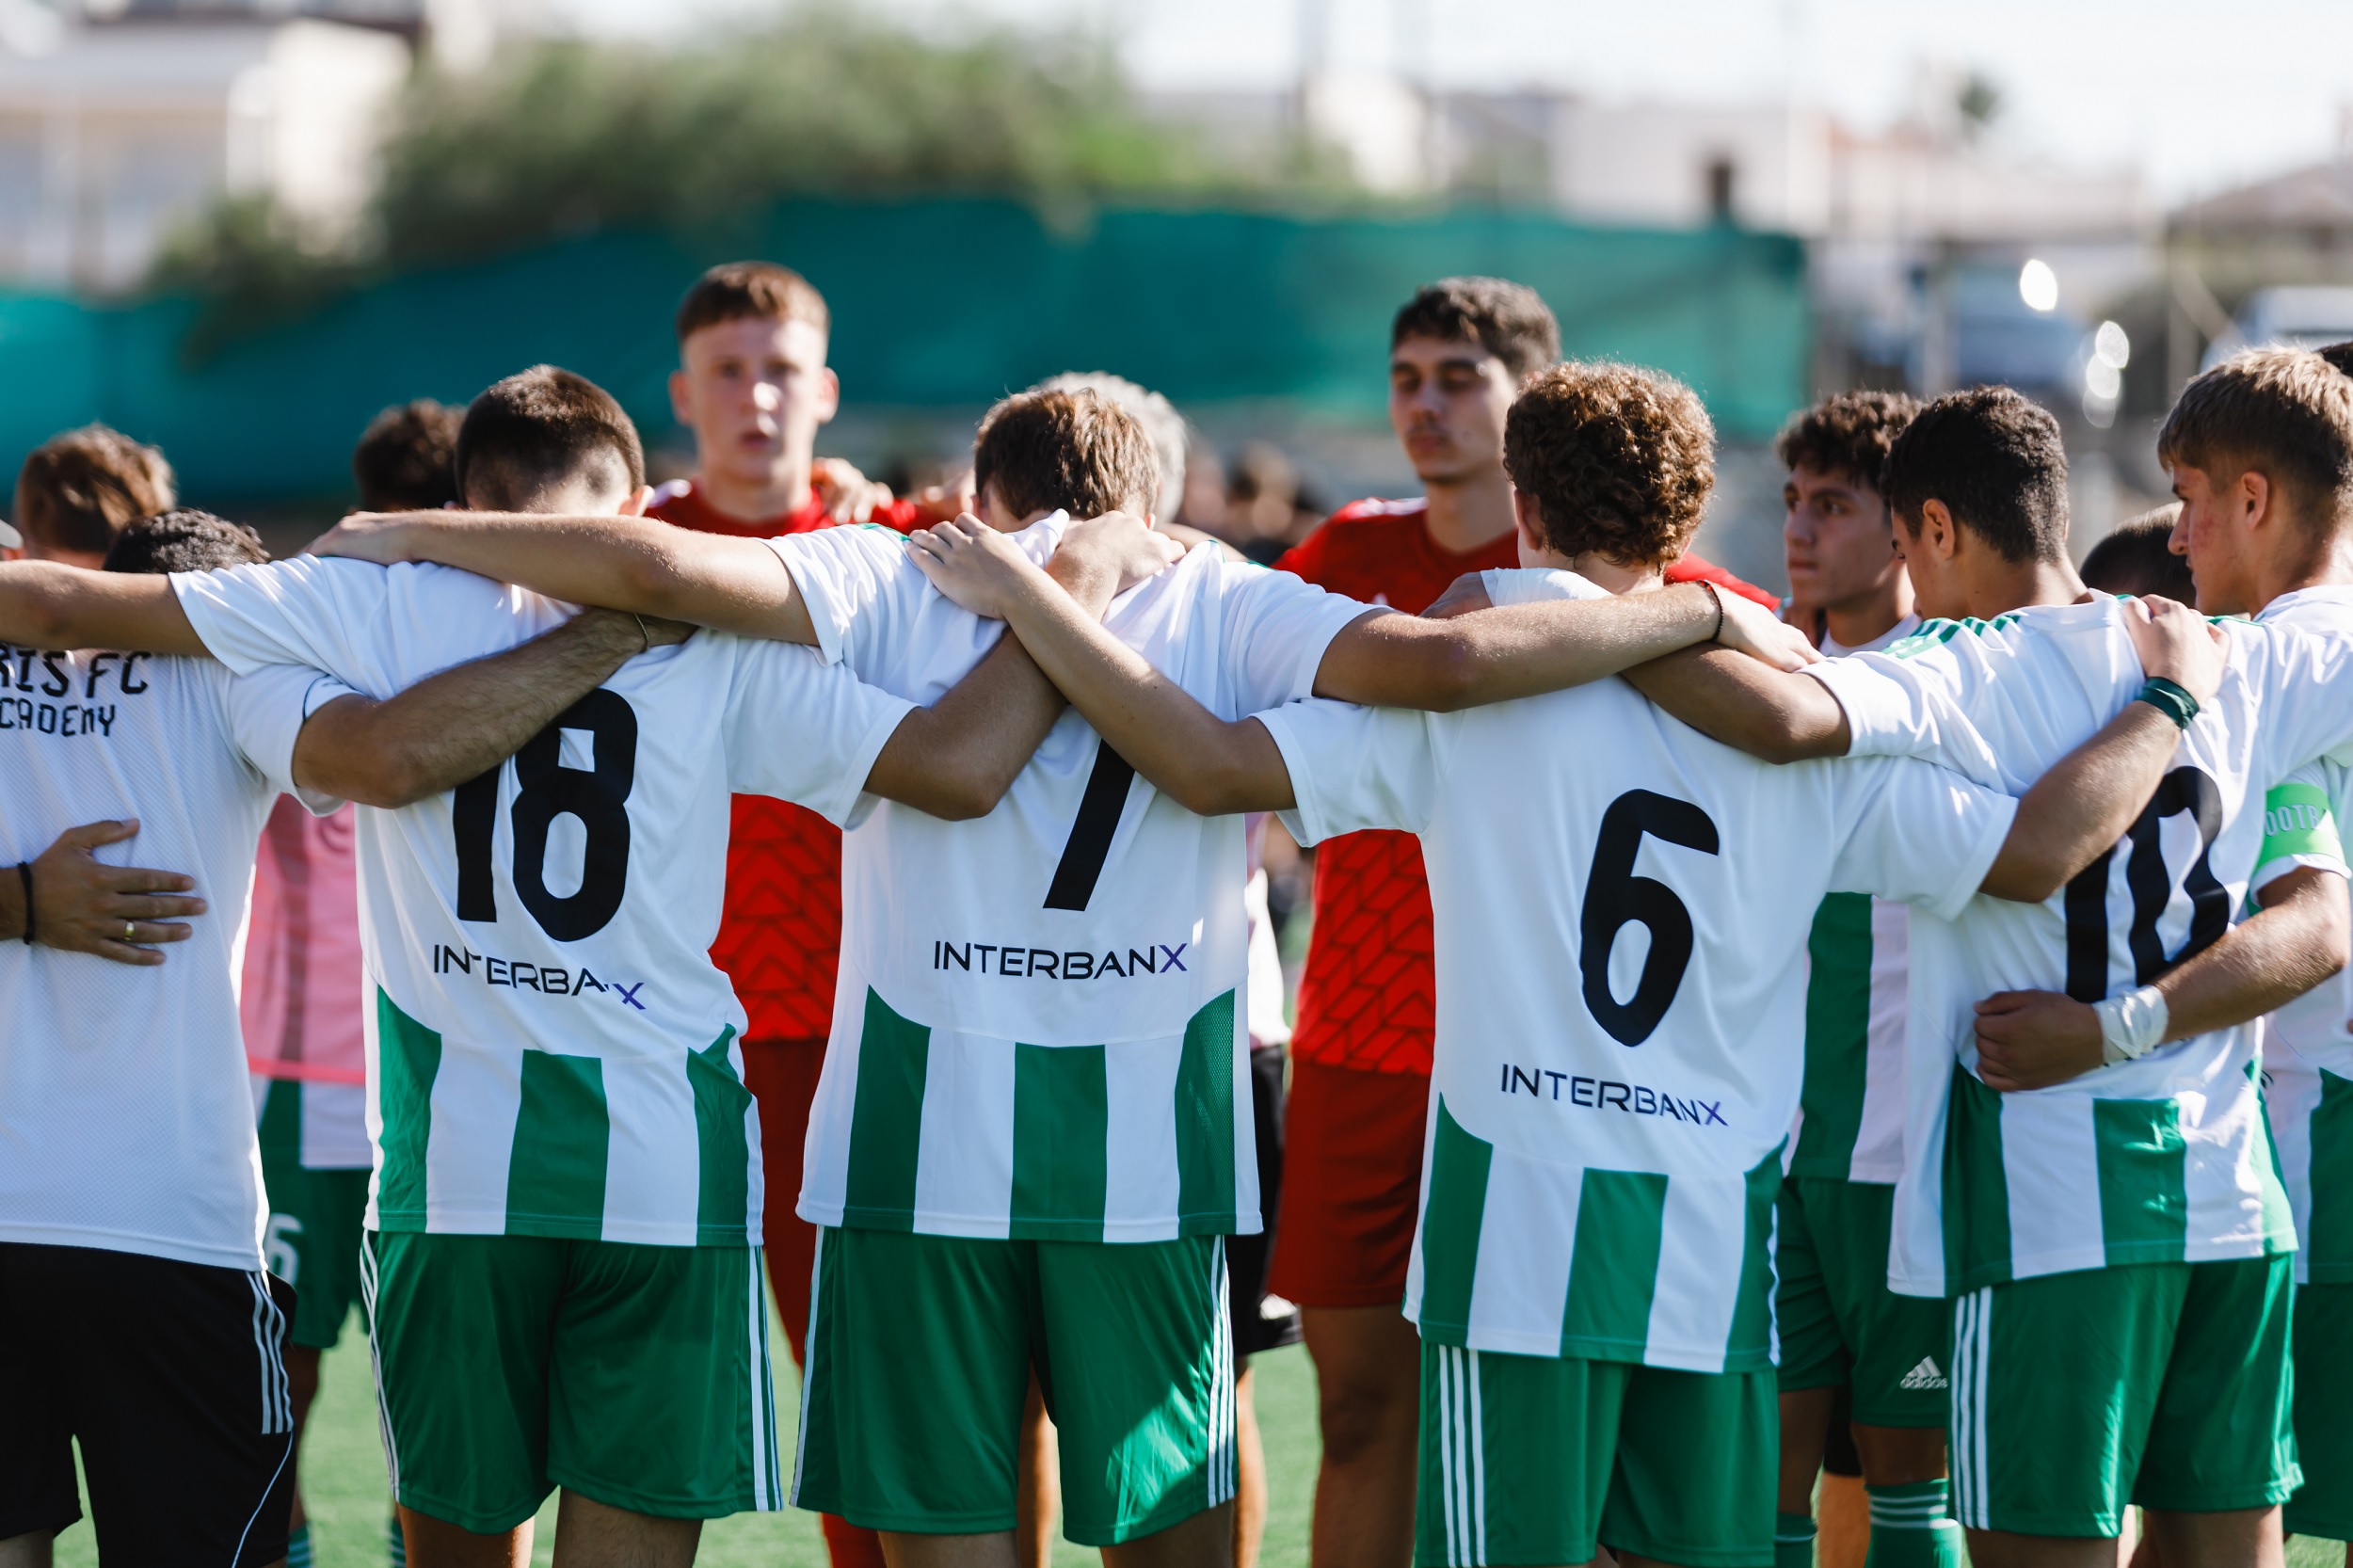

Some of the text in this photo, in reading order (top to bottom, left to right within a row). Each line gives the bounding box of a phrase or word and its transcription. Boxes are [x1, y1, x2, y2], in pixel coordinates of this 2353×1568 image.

[86, 651, 152, 697] FC
[0, 697, 115, 737] CADEMY
[453, 687, 638, 942] 18
[2065, 765, 2230, 1003] 10
[1579, 789, 1720, 1048] 6
[434, 944, 647, 1011] INERBAX
[934, 940, 1188, 980] INTERBANX
[1501, 1064, 1729, 1127] INTERBANX
